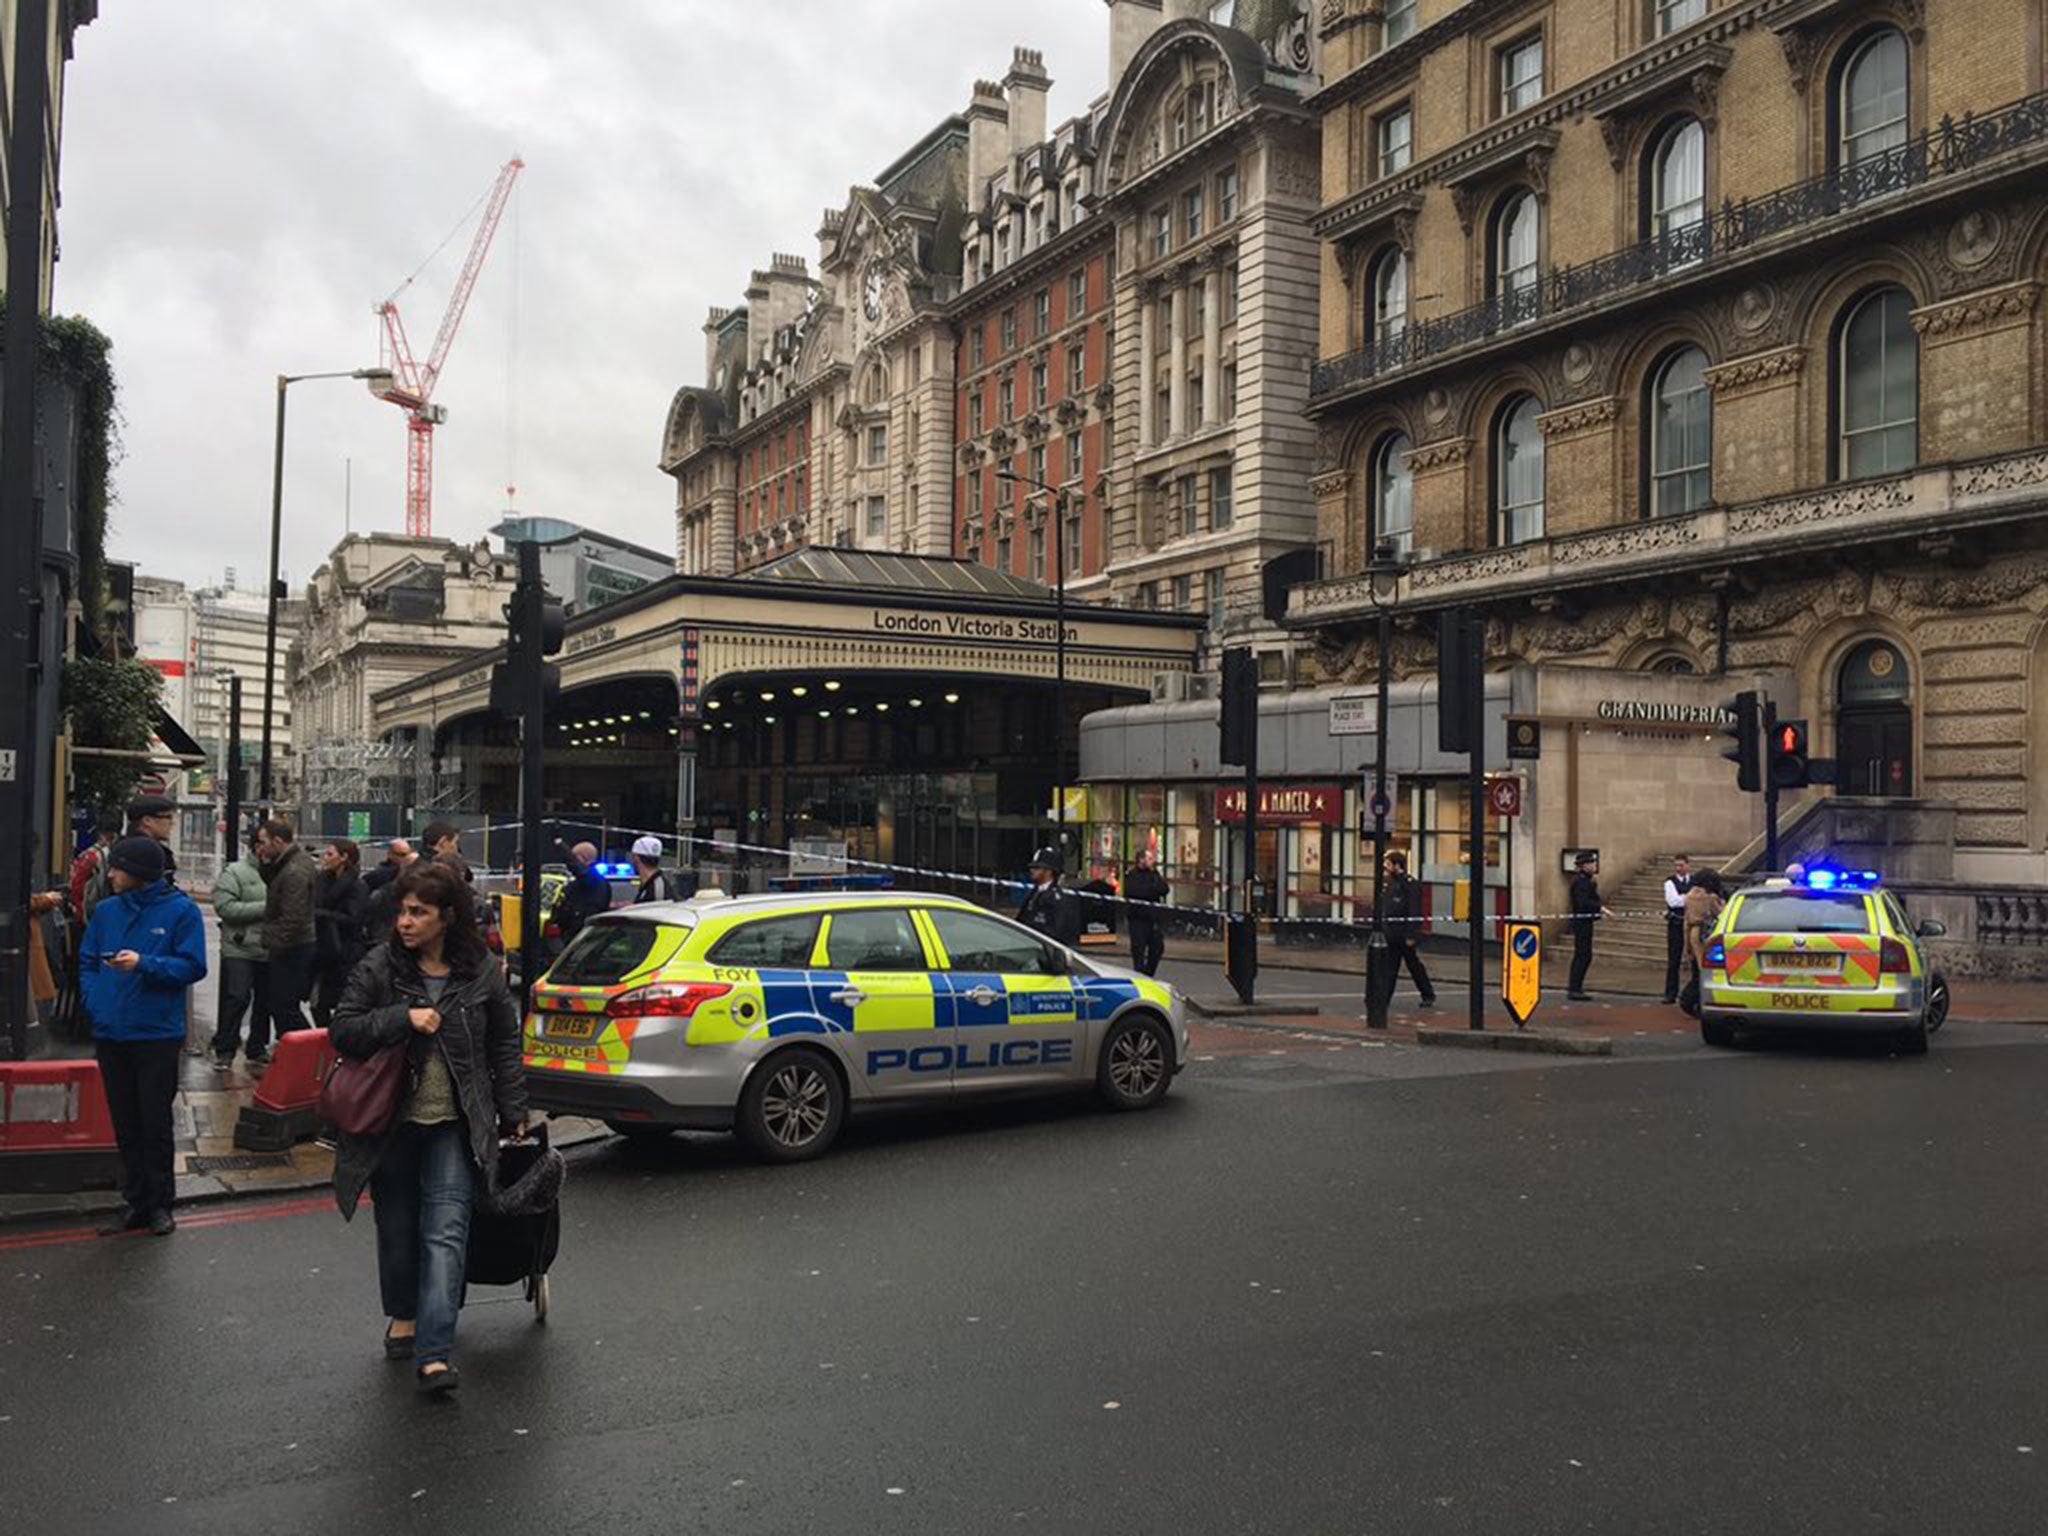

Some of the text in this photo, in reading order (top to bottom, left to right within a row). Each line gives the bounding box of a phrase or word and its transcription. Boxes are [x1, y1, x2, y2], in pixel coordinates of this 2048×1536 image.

[873, 610, 942, 633] London
[946, 615, 1014, 638] Victoria
[1261, 792, 1267, 812] A
[713, 968, 752, 982] FOY
[1037, 1003, 1067, 1011] POLICE
[1772, 993, 1830, 1009] POLICE
[528, 1041, 596, 1058] POLICE
[866, 1038, 1072, 1077] POLICE
